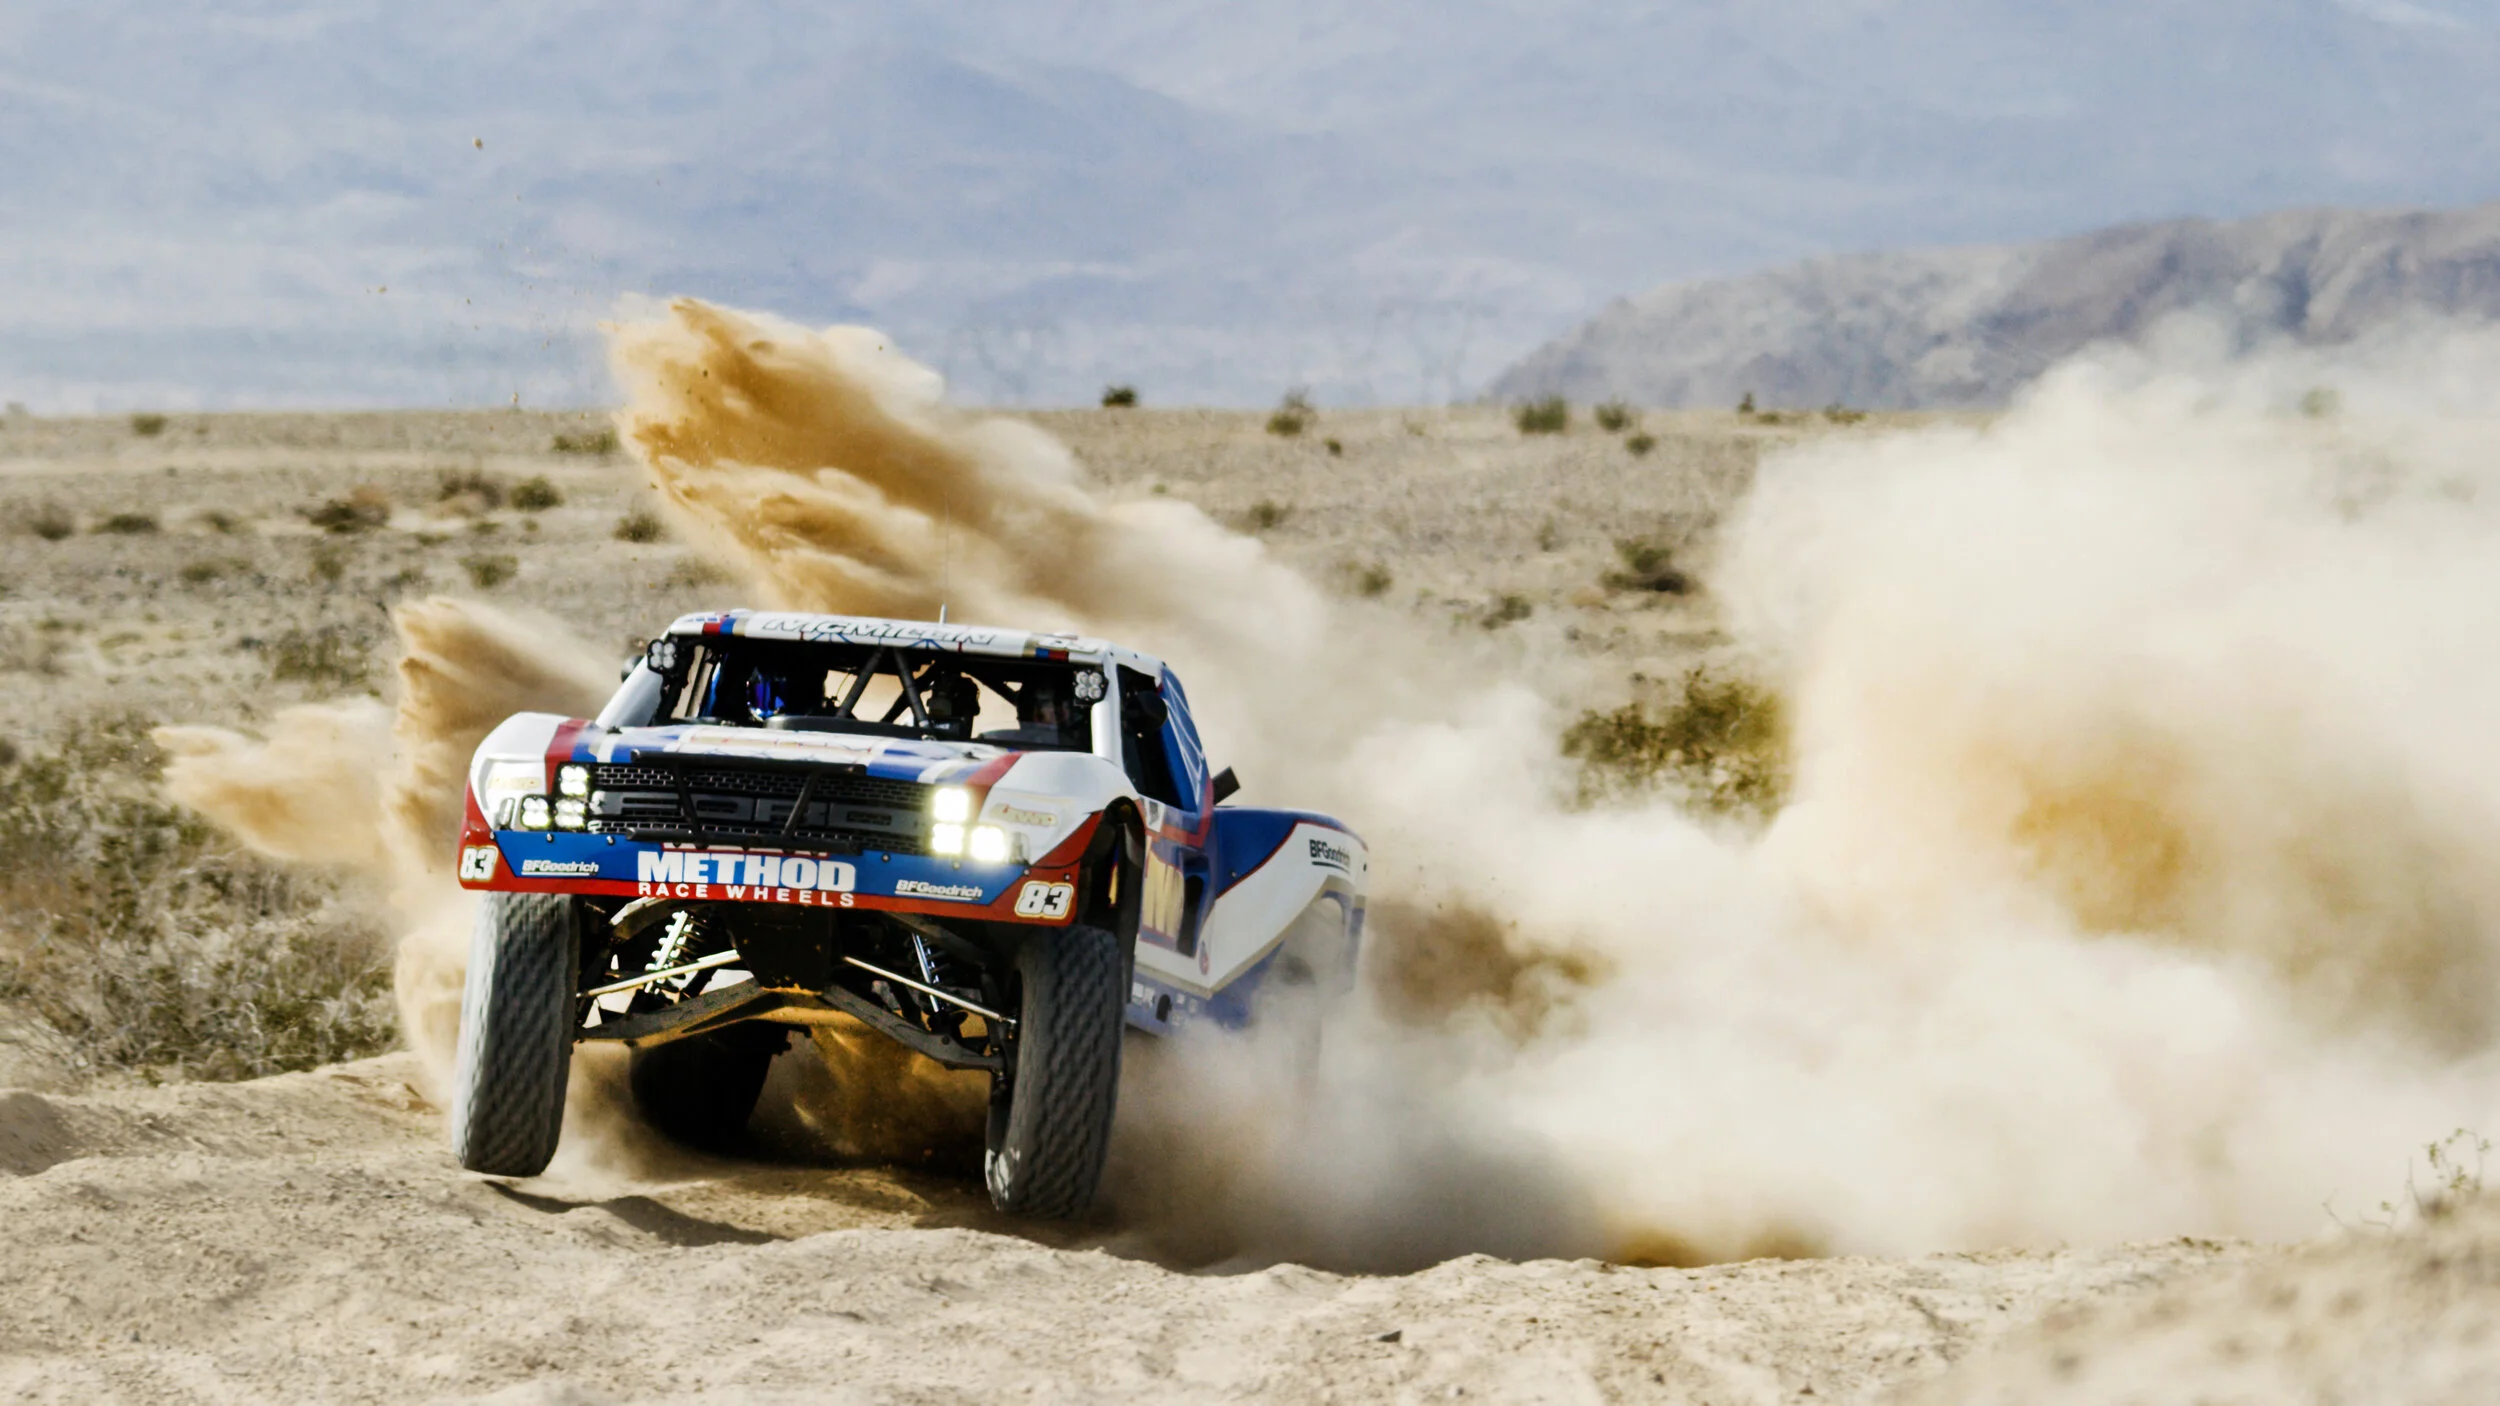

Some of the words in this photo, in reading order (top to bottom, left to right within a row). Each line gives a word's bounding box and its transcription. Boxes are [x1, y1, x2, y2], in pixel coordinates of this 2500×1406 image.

[459, 846, 499, 880] 83
[521, 859, 599, 873] BFGoodrich
[638, 850, 856, 892] METHOD
[638, 882, 708, 898] RACE
[726, 884, 855, 907] WHEELS
[896, 879, 983, 898] BFGoodrich
[1015, 881, 1073, 919] 83
